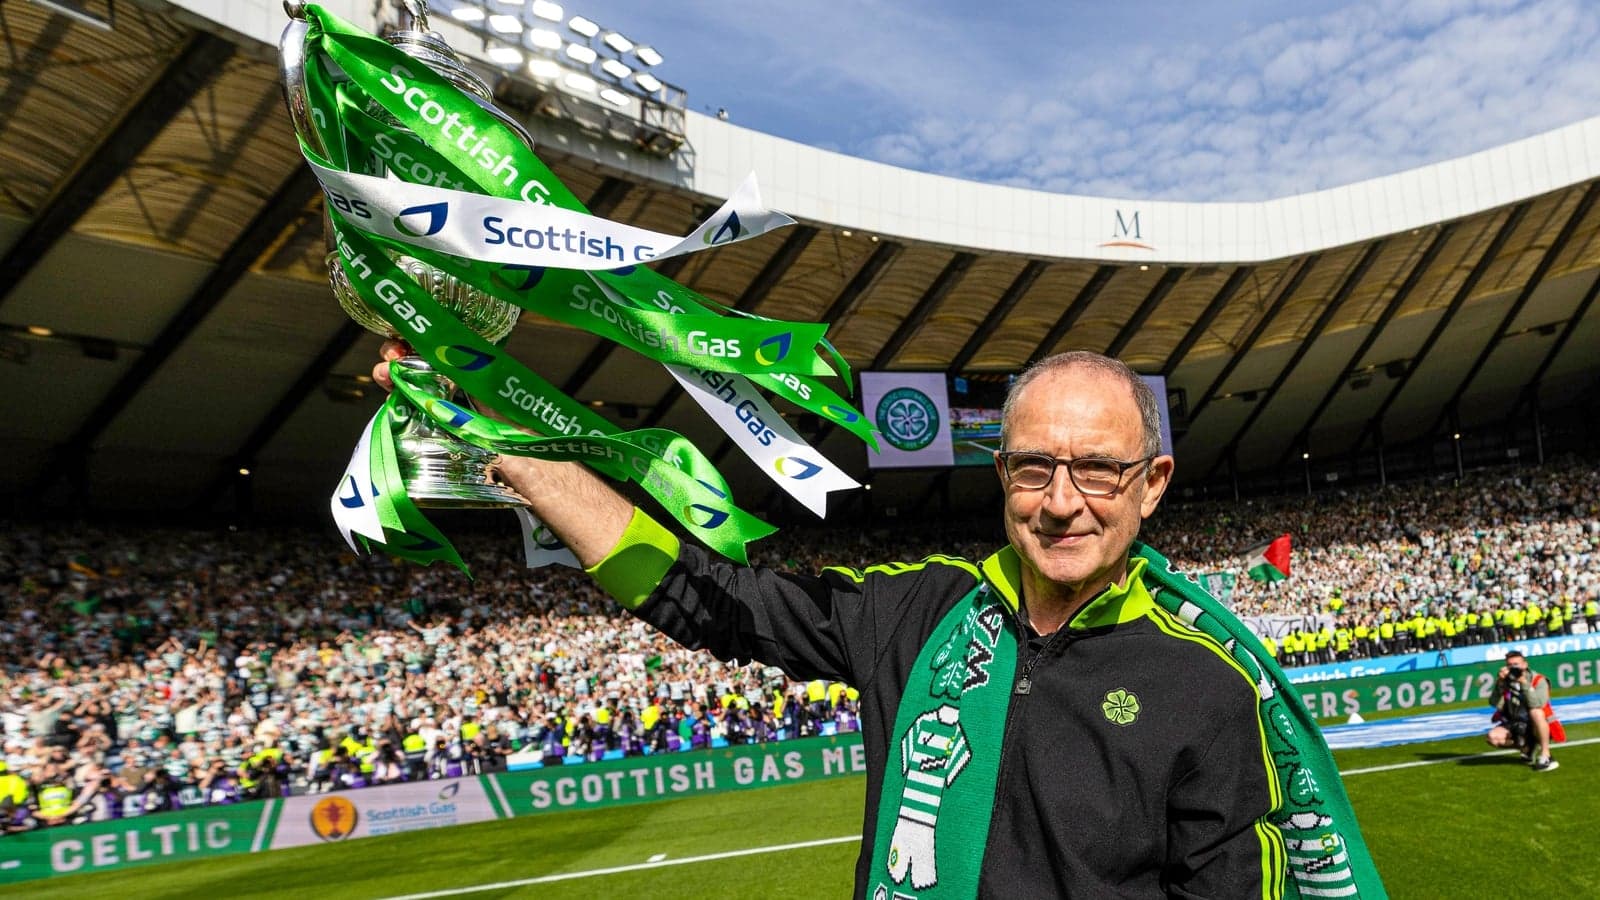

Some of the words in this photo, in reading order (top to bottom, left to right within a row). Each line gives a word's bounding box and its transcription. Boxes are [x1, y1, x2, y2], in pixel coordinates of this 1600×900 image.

[380, 64, 519, 187] Scottish
[482, 215, 625, 262] Scottish
[1112, 209, 1142, 238] M
[374, 278, 433, 334] Gas
[569, 284, 679, 352] Scottish
[687, 331, 742, 358] Gas
[498, 376, 583, 437] Scottish
[735, 400, 777, 447] Gas
[494, 442, 624, 463] Scottish
[1375, 672, 1494, 711] 2025/2
[530, 760, 716, 809] SCOTTISH
[734, 751, 805, 785] GAS
[366, 804, 425, 821] Scottish
[429, 801, 456, 815] Gas
[51, 819, 231, 873] CELTIC
